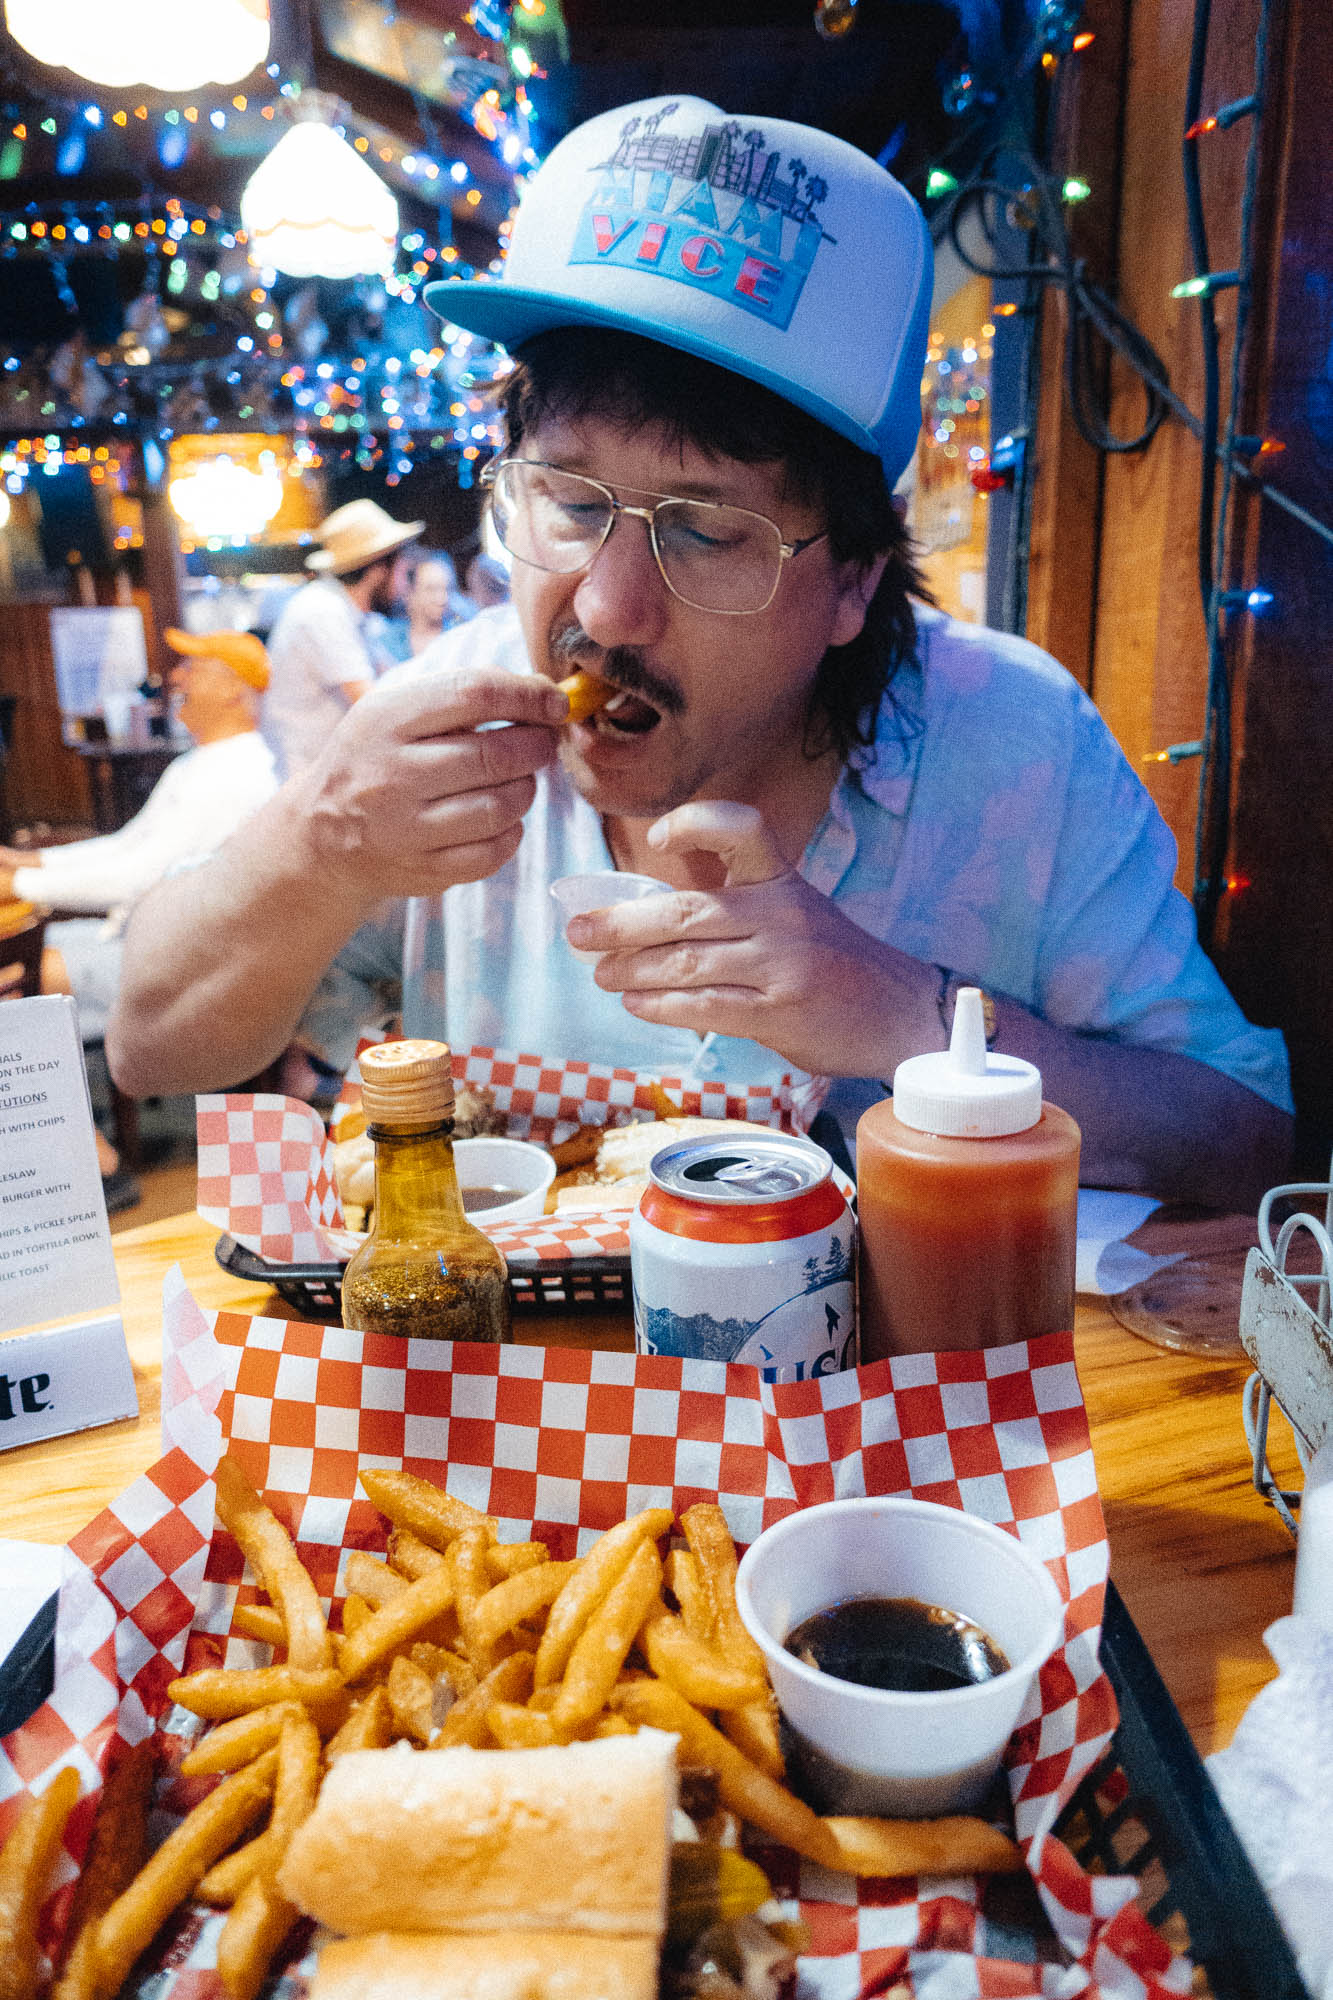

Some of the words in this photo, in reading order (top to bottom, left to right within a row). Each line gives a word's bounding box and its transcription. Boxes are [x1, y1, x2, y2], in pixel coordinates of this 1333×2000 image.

[583, 166, 823, 268] MIAMI
[591, 214, 784, 311] VICE
[15, 1064, 36, 1075] THE
[38, 1060, 60, 1072] DAY
[8, 1121, 36, 1133] WITH
[37, 1115, 66, 1128] CHIPS
[0, 1168, 37, 1183] ESLAW
[2, 1188, 43, 1204] BURGER
[45, 1183, 72, 1195] WITH
[23, 1225, 32, 1234] &
[34, 1217, 66, 1232] PICKLE
[67, 1210, 98, 1224] SPEAR
[12, 1248, 24, 1257] IN
[26, 1238, 71, 1254] TORTILLA
[72, 1231, 102, 1244] BOWL
[19, 1263, 50, 1277] TOAST
